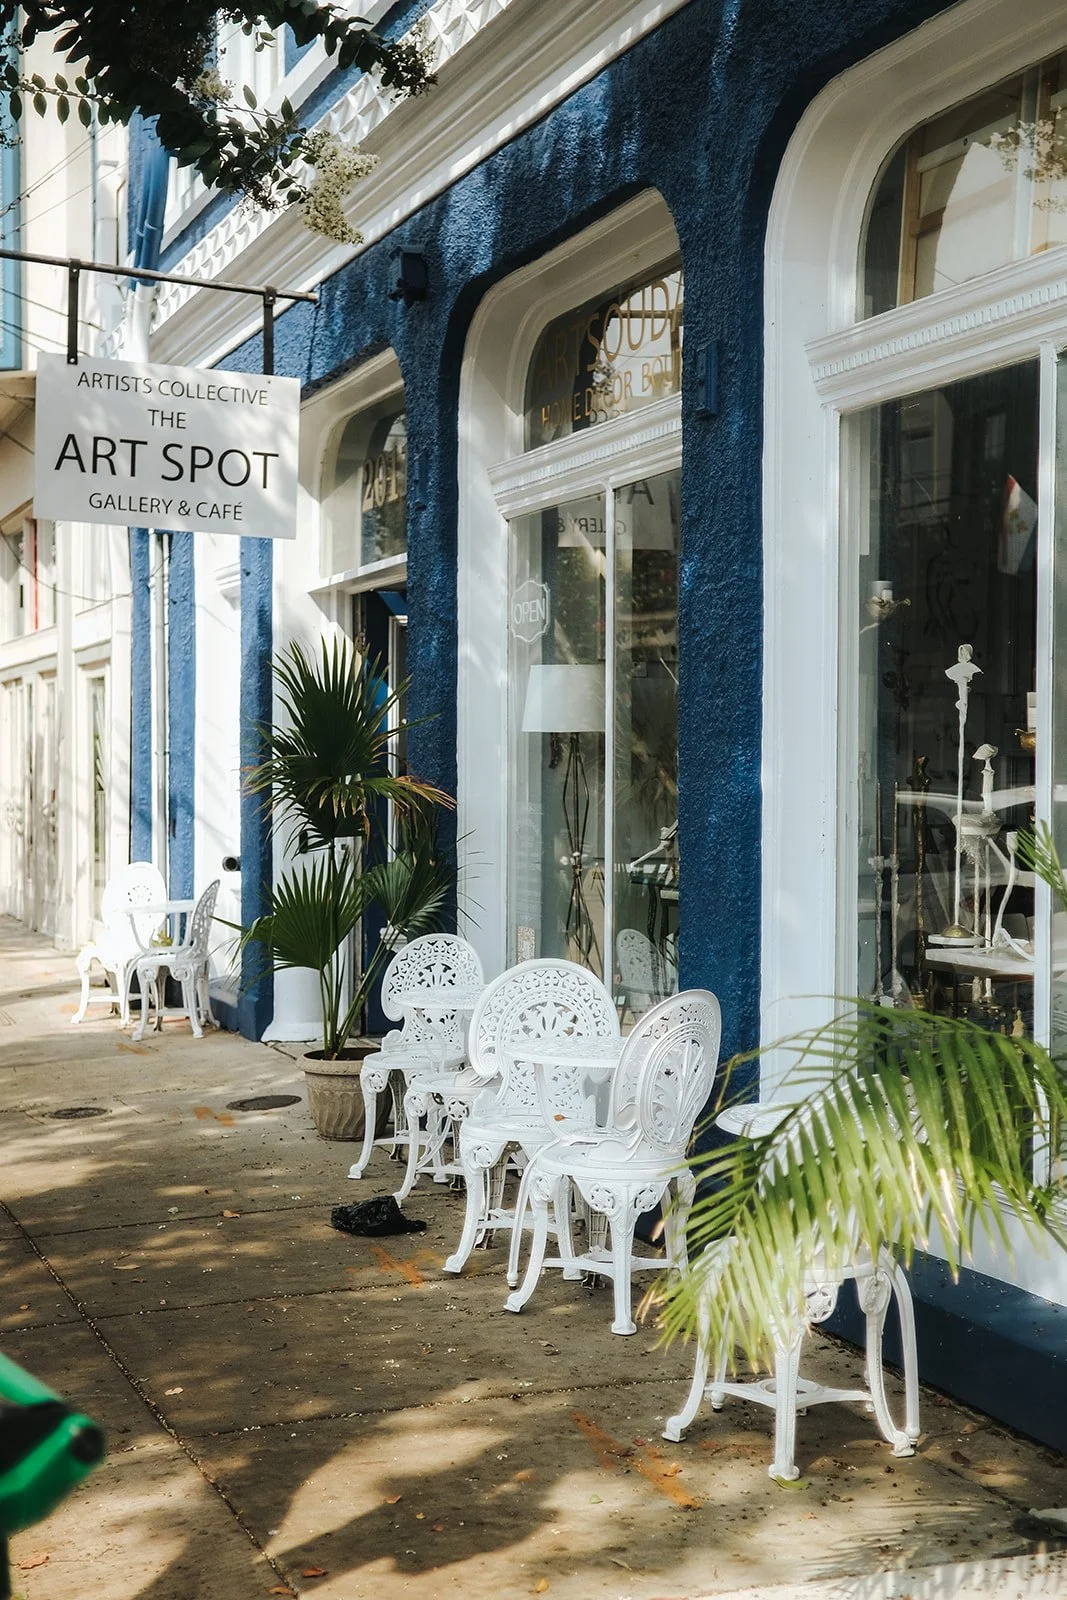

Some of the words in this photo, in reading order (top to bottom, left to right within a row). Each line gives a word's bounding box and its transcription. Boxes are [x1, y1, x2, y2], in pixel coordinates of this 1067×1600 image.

[77, 371, 153, 394] ARTISTS
[157, 379, 269, 406] COLLECTIVE
[585, 370, 633, 417] DCOR
[147, 408, 187, 430] THE
[54, 432, 149, 478] ART
[160, 442, 280, 490] SPOT
[88, 492, 174, 515] GALLERY
[177, 499, 192, 517] &
[195, 501, 243, 521] CAFÉ
[513, 597, 546, 625] OPEN
